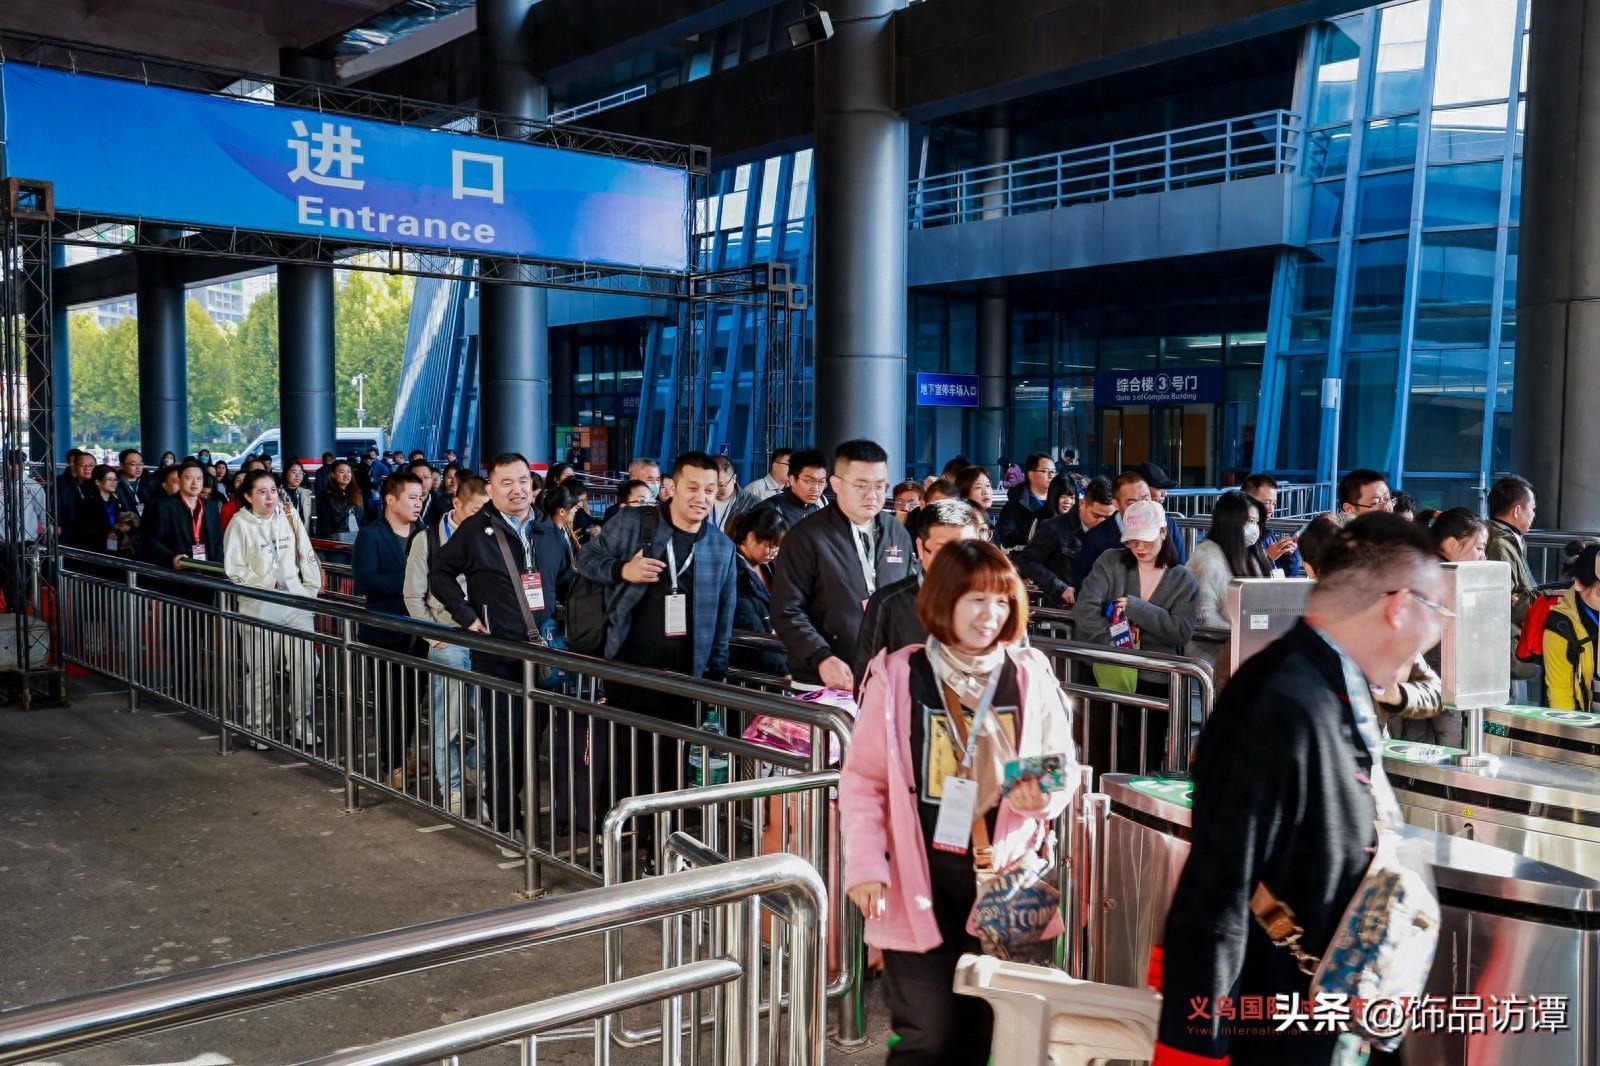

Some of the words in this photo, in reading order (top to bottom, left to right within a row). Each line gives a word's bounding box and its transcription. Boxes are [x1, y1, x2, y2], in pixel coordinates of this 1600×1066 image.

[287, 120, 504, 204] 进口
[298, 195, 496, 244] Entrance
[920, 382, 977, 397] 地下室停车场入口
[1171, 392, 1197, 400] Building
